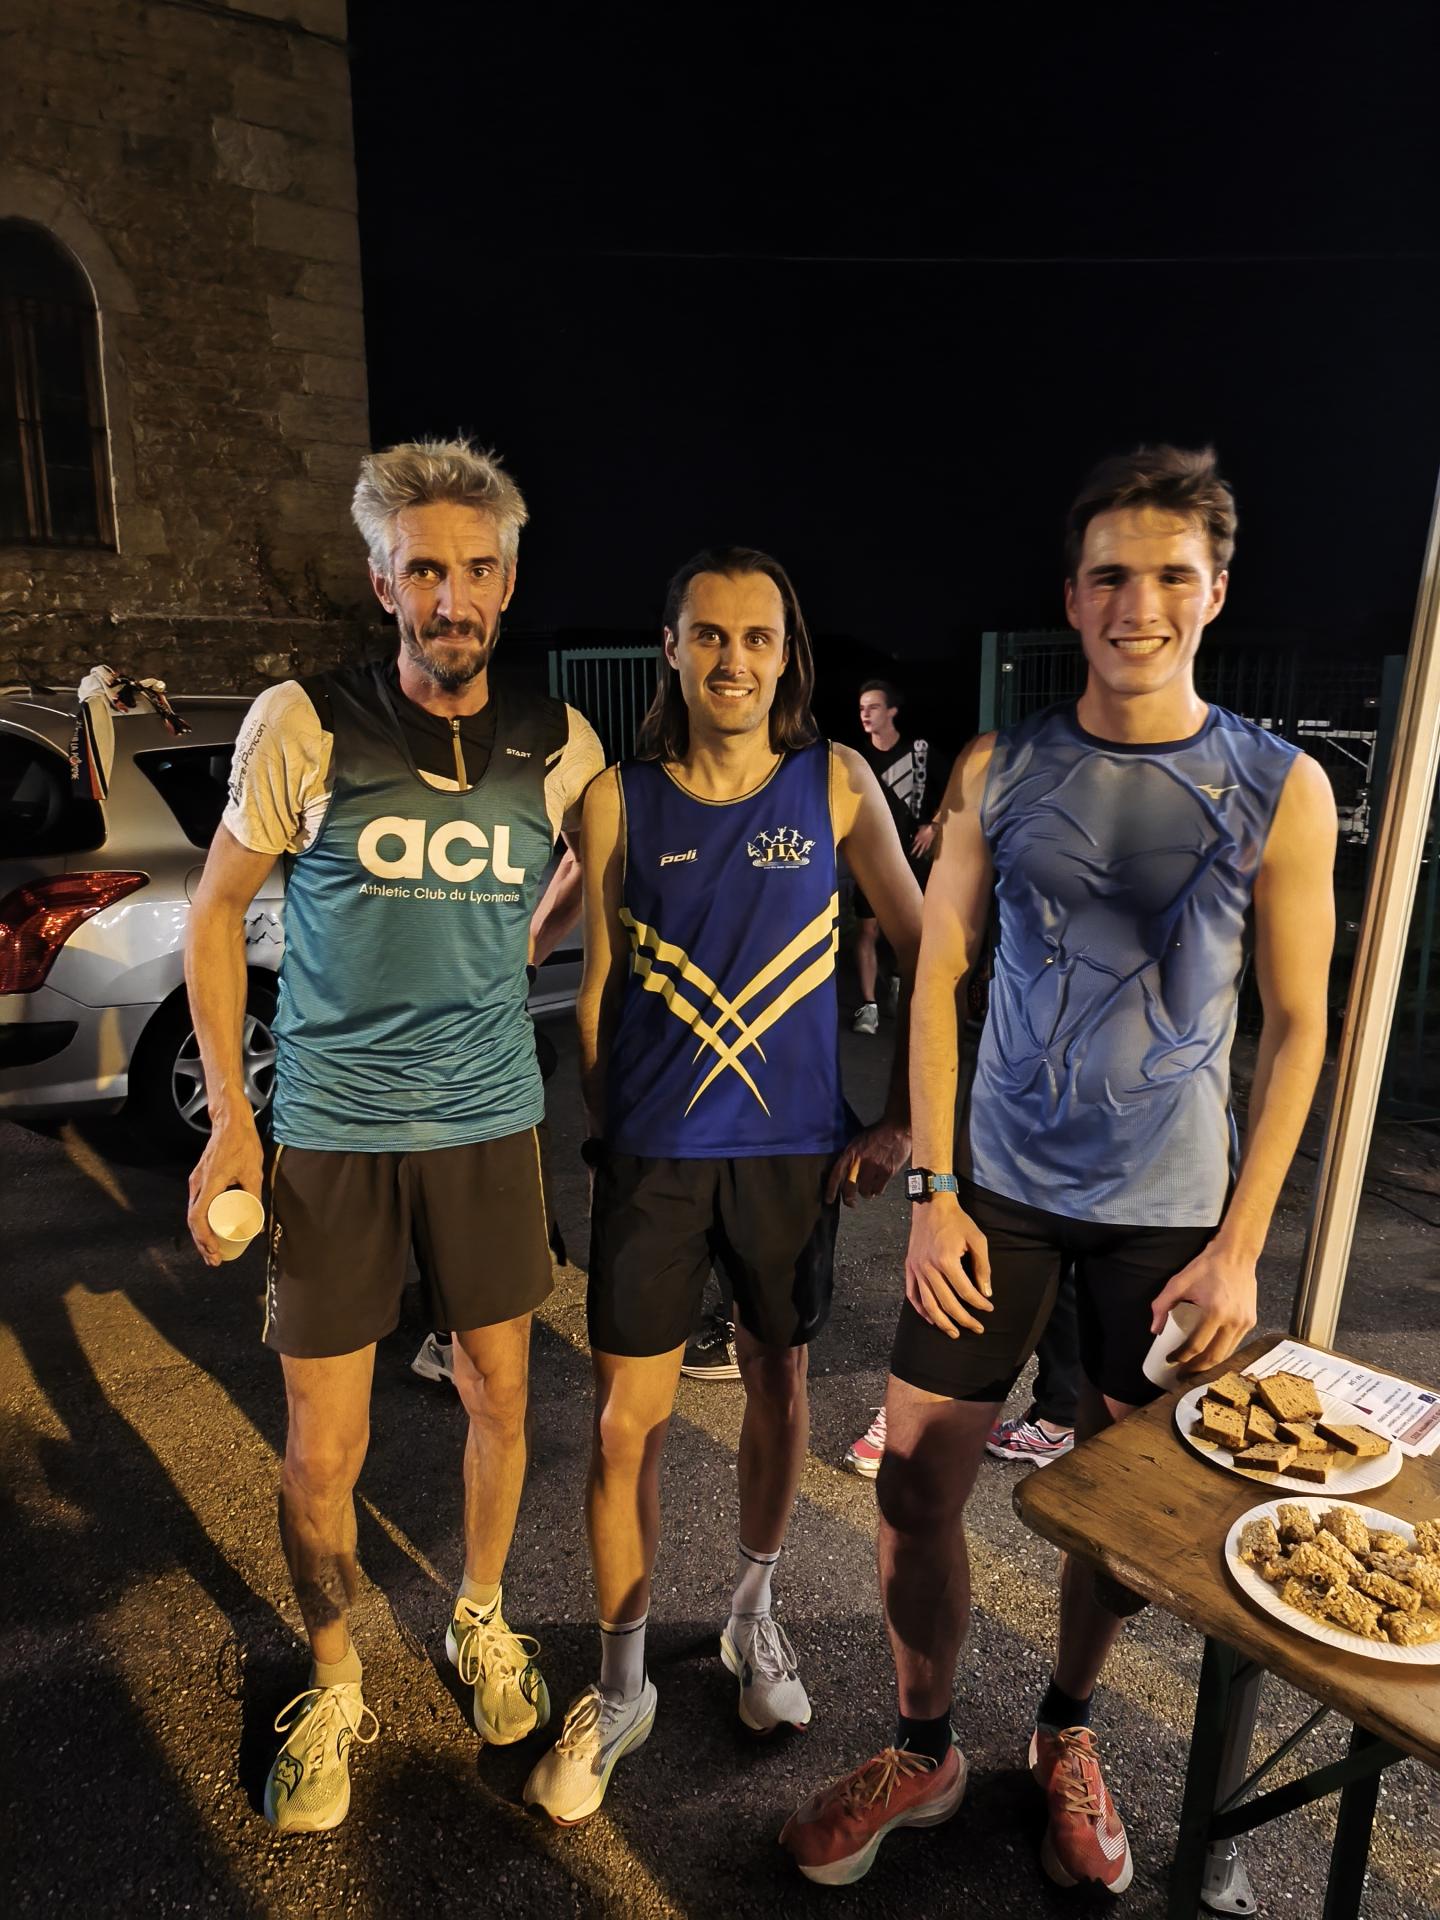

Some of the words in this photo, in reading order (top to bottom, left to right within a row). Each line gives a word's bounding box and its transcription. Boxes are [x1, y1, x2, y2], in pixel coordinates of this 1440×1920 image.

[506, 748, 532, 758] START
[660, 849, 697, 866] poli
[762, 843, 801, 862] JTA
[359, 883, 410, 898] Athletic
[414, 887, 446, 900] Club
[450, 889, 466, 901] du
[470, 890, 520, 904] Lyonnais
